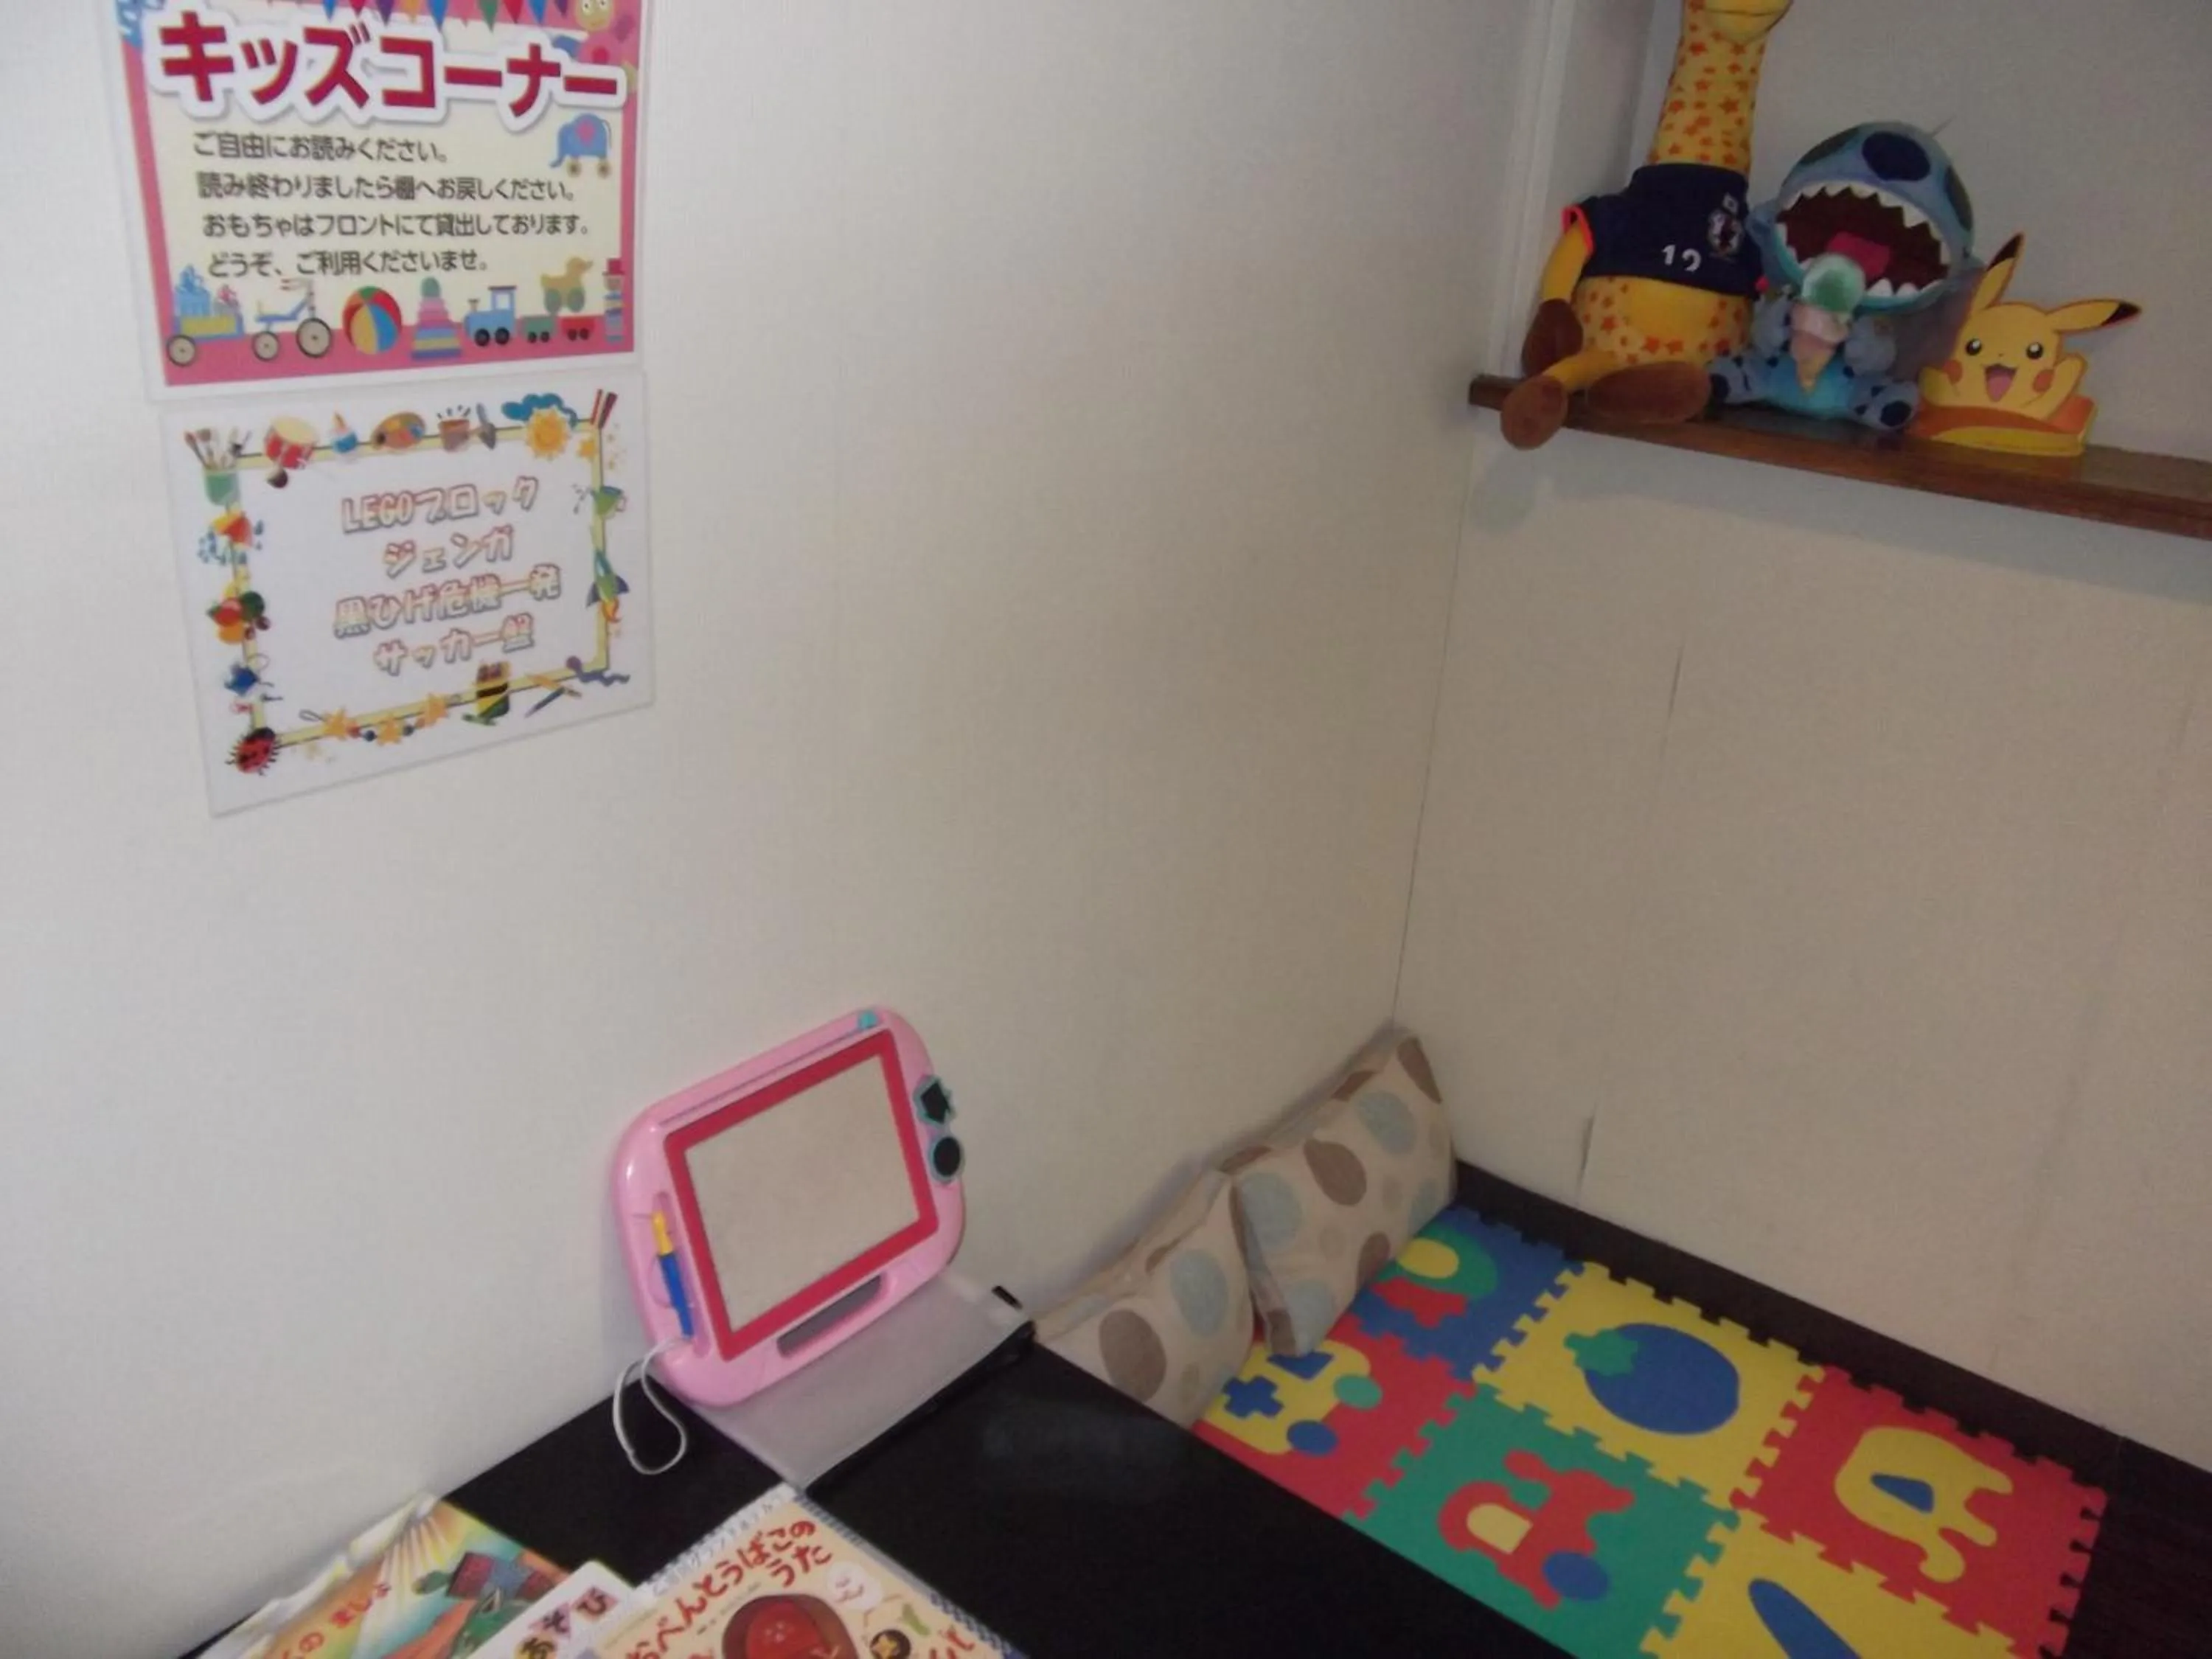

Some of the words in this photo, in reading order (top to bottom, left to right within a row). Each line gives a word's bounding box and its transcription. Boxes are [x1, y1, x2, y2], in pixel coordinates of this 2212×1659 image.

[159, 10, 619, 116] キッズコーナー
[194, 131, 449, 164] ご自由にお読みください。
[195, 170, 575, 203] 読み終わりましたら棚へお戻しください。
[203, 213, 588, 239] おもちゃはフロントにて貸出しております。
[209, 251, 487, 278] どうぞ、ご利用くださいませ。
[383, 523, 514, 580] ジェンガ
[765, 1545, 832, 1587] うた
